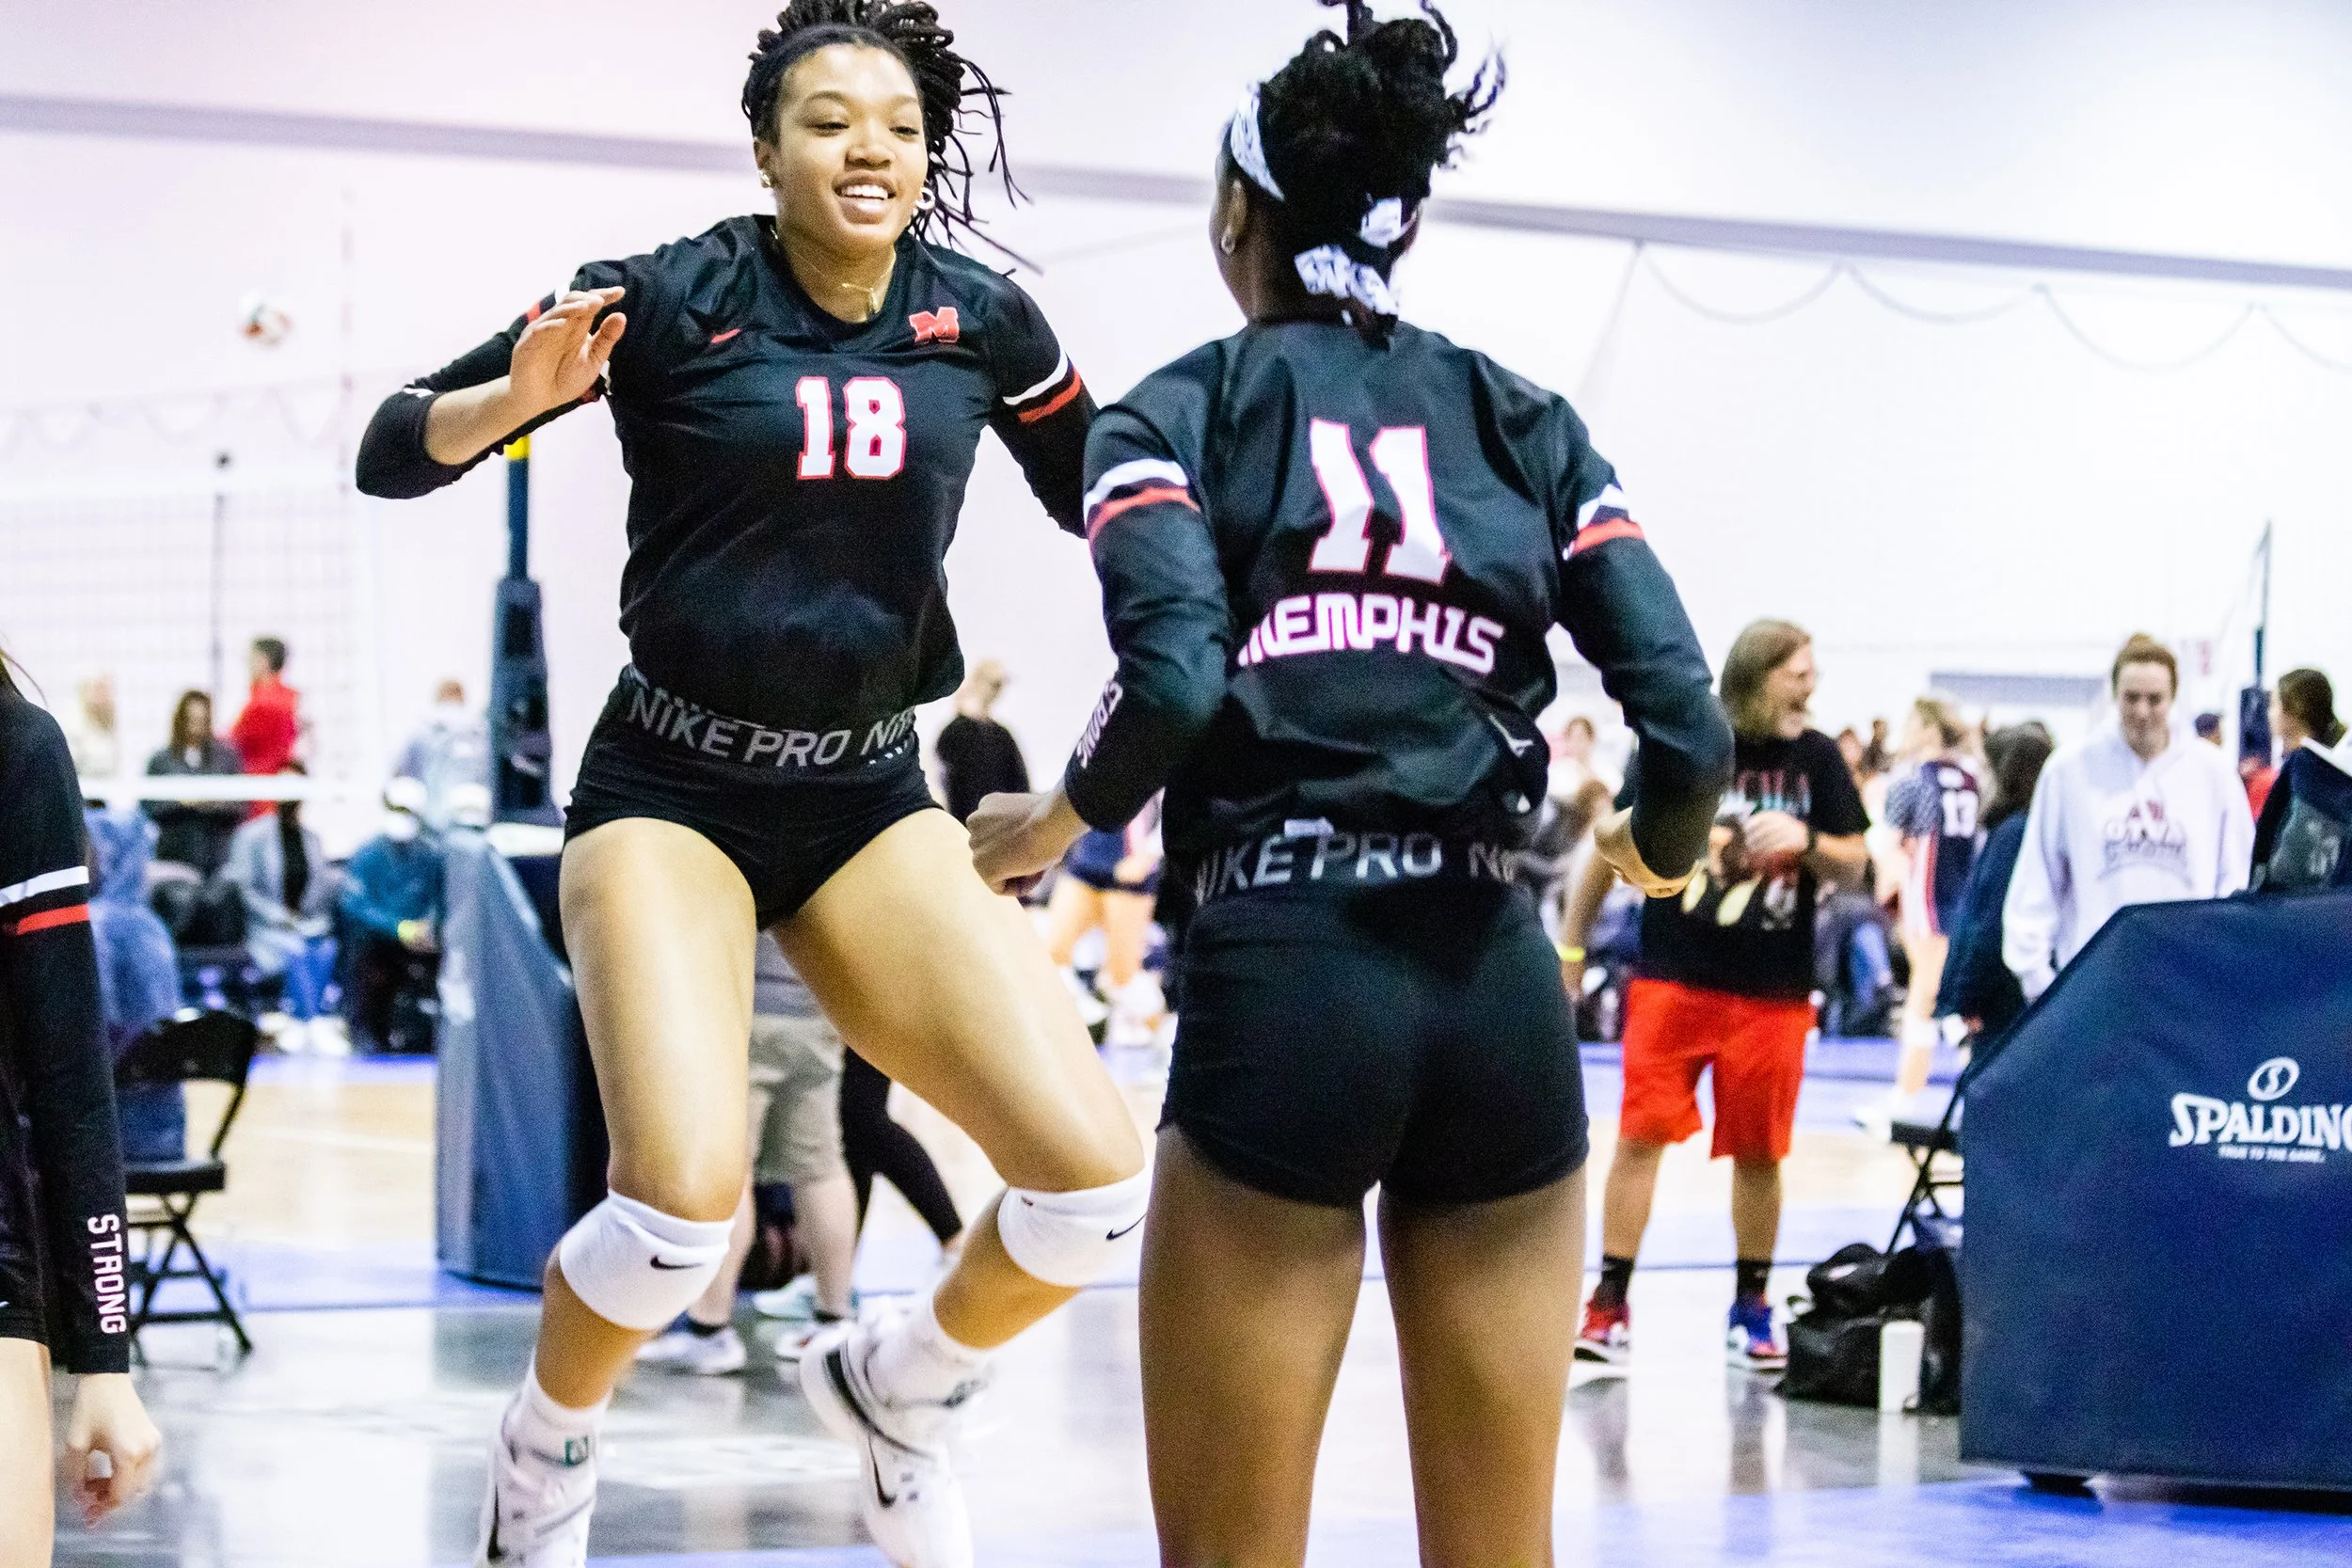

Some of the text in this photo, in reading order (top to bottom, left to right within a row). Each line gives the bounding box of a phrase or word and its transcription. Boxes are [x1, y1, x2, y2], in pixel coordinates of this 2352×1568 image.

[909, 306, 960, 344] M
[795, 376, 907, 481] 18
[1309, 417, 1453, 585] 11
[627, 686, 740, 758] NIKE
[742, 728, 852, 768] PRO
[1310, 830, 1443, 880] PRO
[87, 1213, 127, 1334] STRONG
